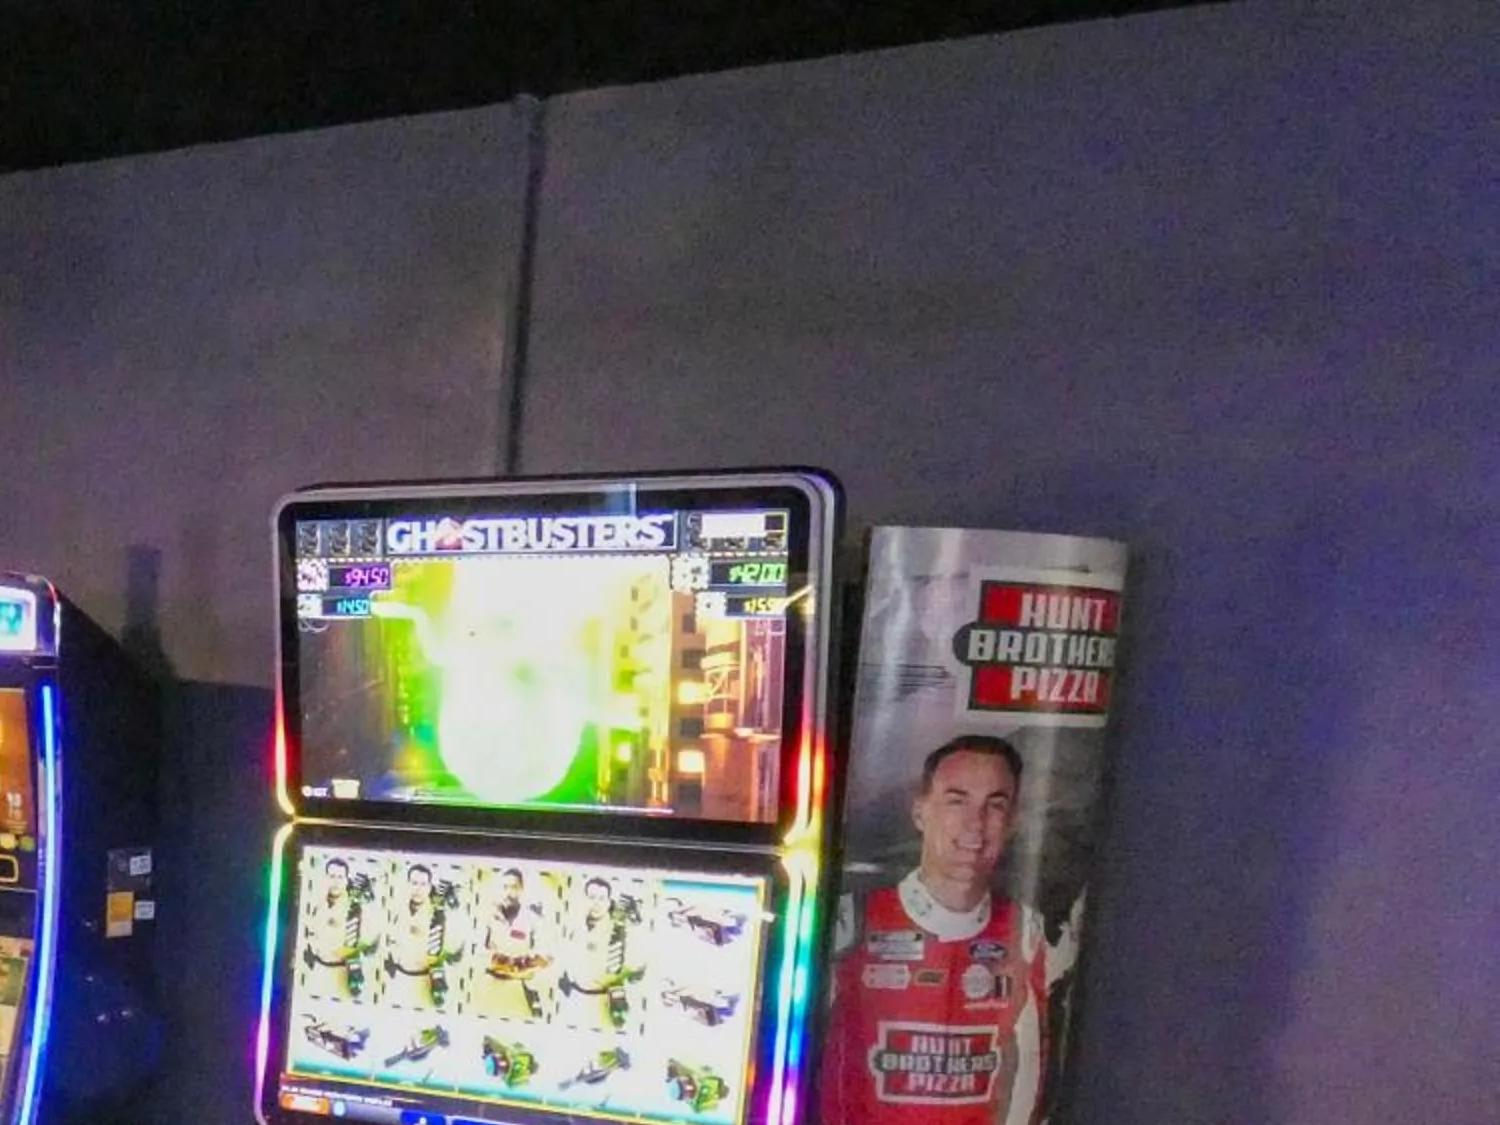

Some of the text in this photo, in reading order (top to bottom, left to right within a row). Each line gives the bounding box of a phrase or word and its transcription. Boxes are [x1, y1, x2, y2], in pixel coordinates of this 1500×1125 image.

[1020, 593, 1106, 631] HUNT
[967, 629, 1116, 667] BROTHER
[1011, 665, 1100, 703] PIZZA
